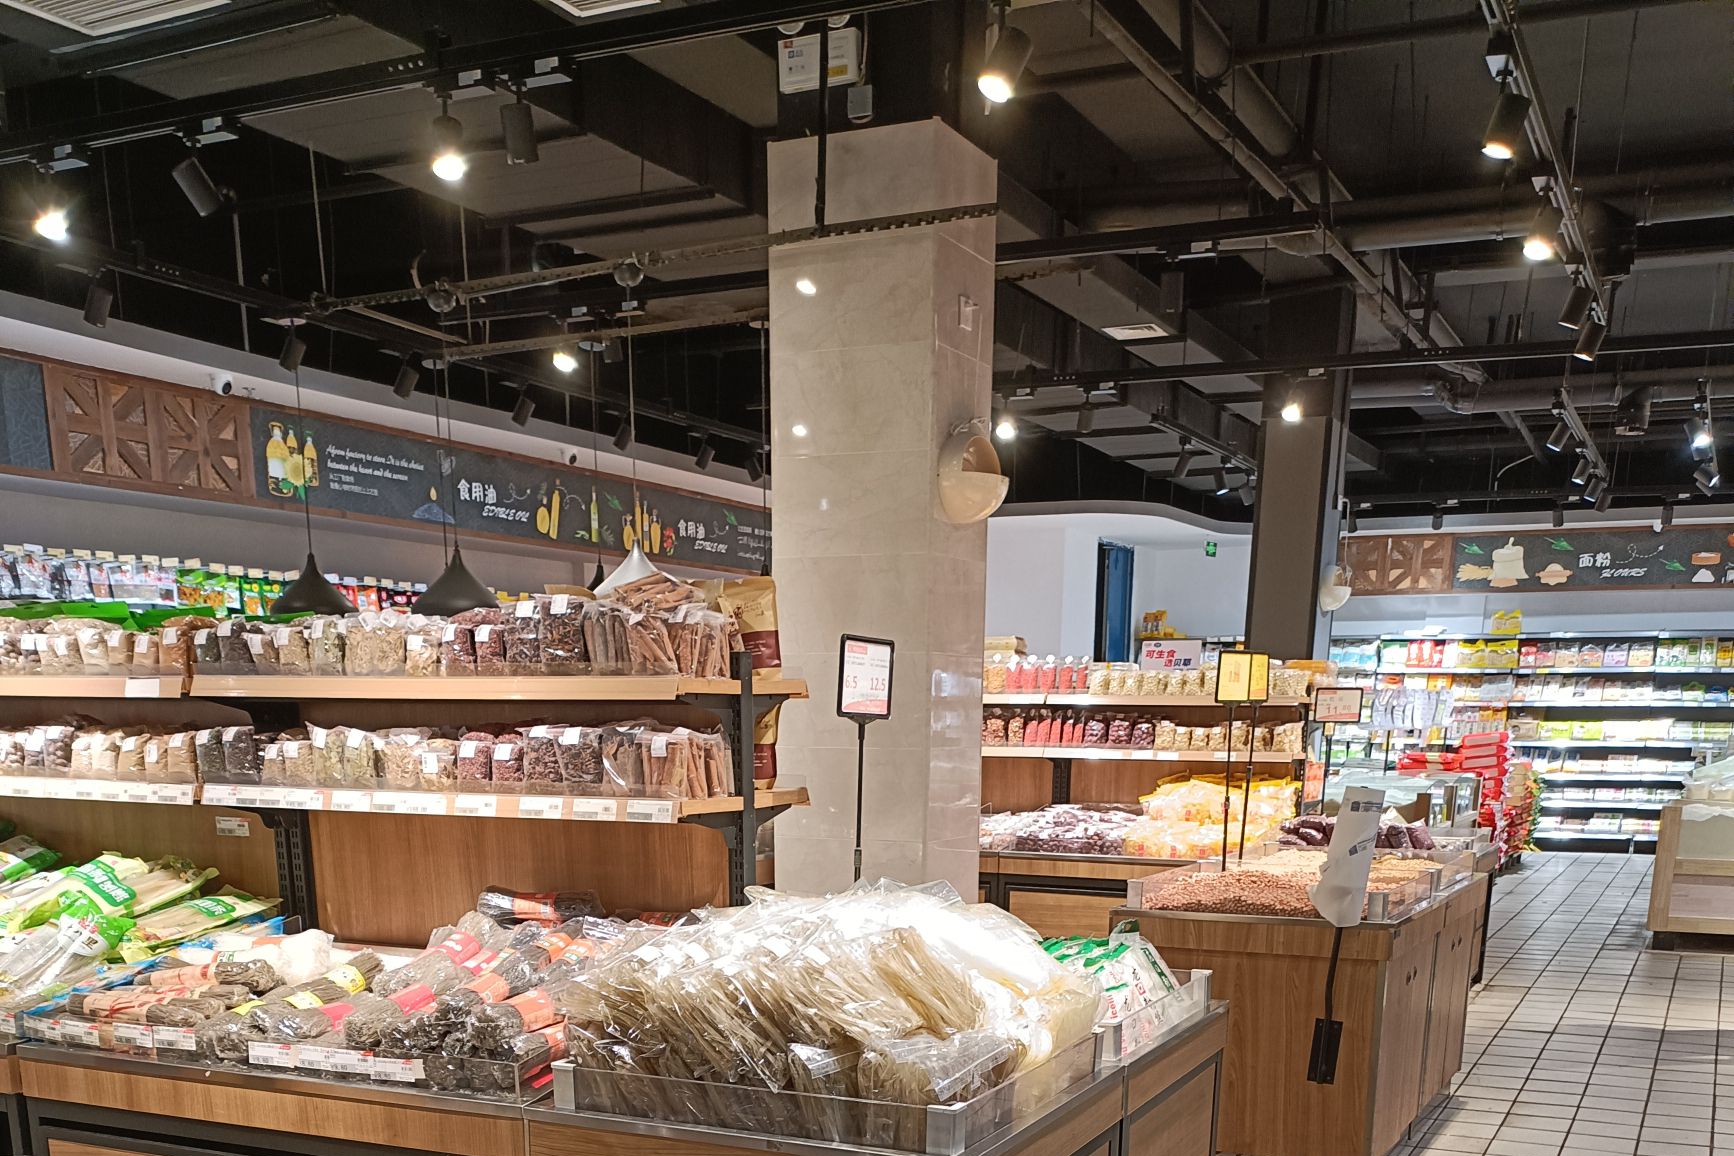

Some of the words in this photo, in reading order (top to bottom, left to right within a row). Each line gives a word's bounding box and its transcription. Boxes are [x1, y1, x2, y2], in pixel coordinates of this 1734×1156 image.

[457, 478, 497, 504] 食用油
[482, 505, 516, 520] EDIBLE
[515, 511, 530, 522] OIL
[678, 519, 705, 539] 食用油
[1578, 552, 1611, 568] 面粉
[1145, 649, 1176, 659] 可生食
